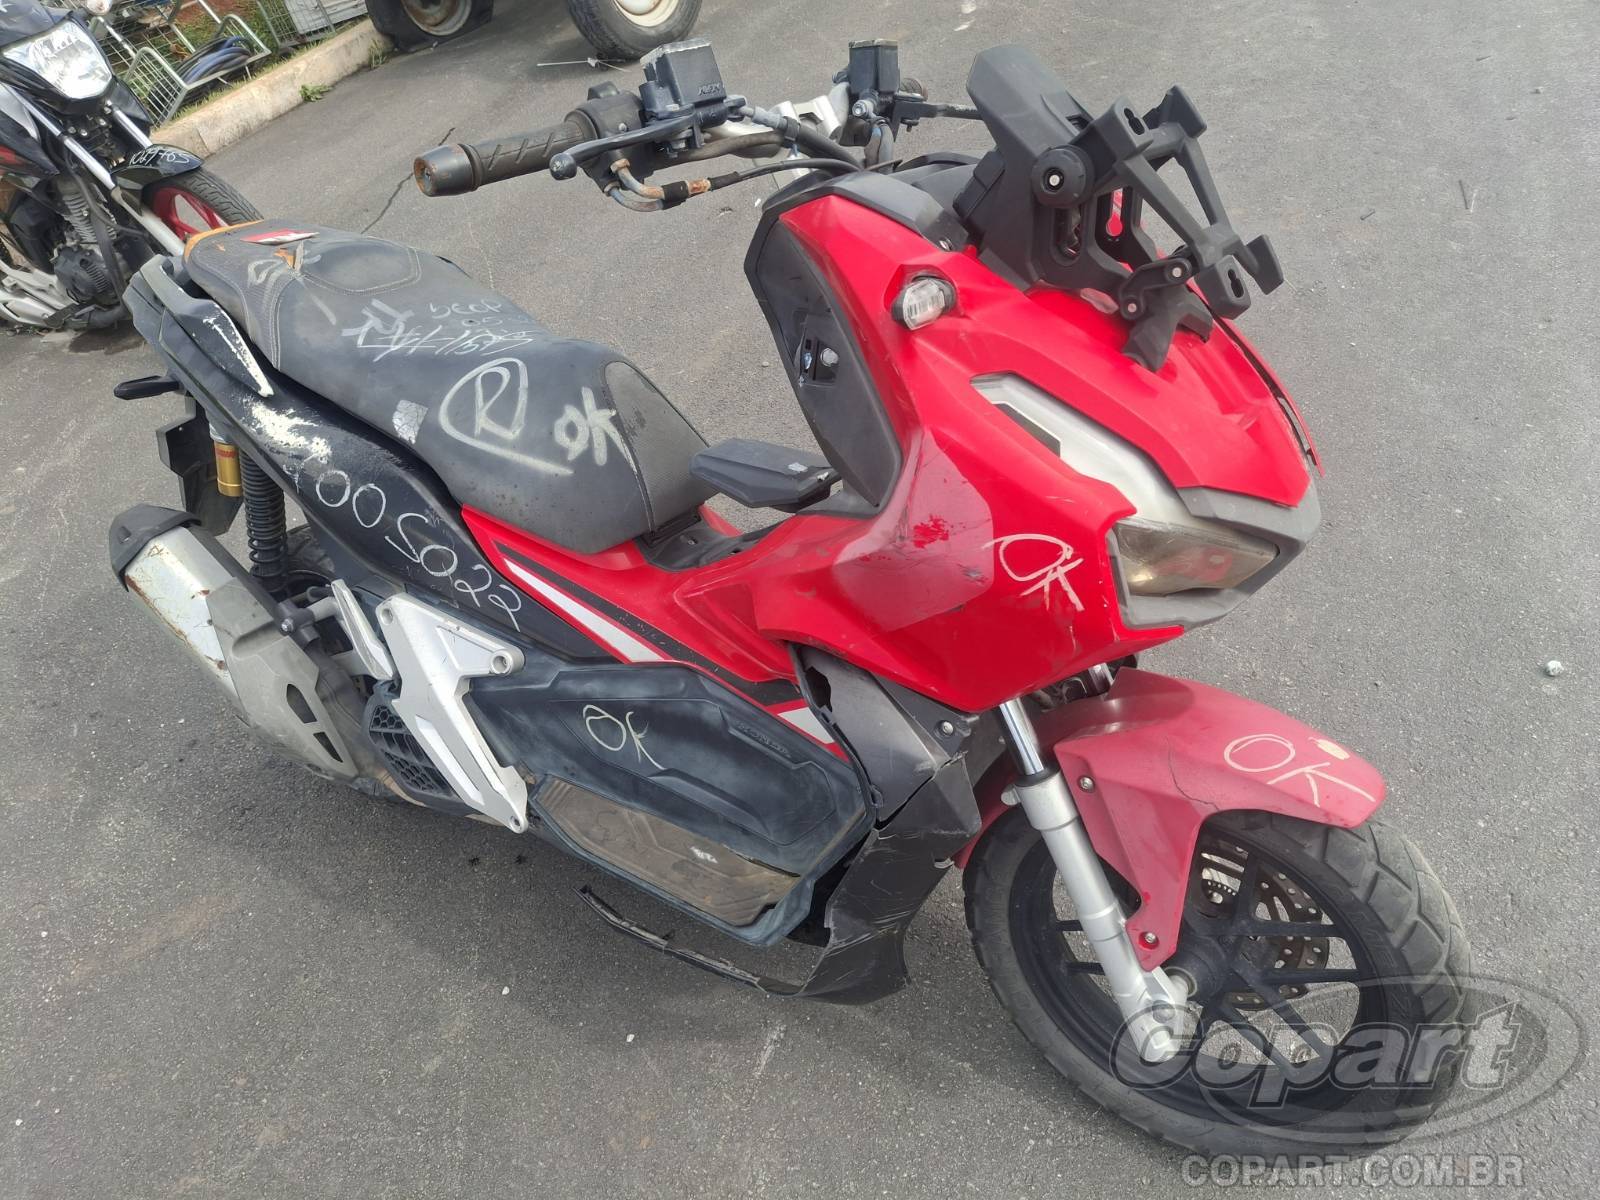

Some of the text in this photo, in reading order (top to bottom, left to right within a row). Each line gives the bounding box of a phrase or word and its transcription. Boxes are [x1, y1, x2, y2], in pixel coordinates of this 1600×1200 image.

[554, 386, 640, 475] OK
[981, 533, 1085, 612] OK
[583, 704, 665, 770] OK
[1224, 733, 1376, 808] OK
